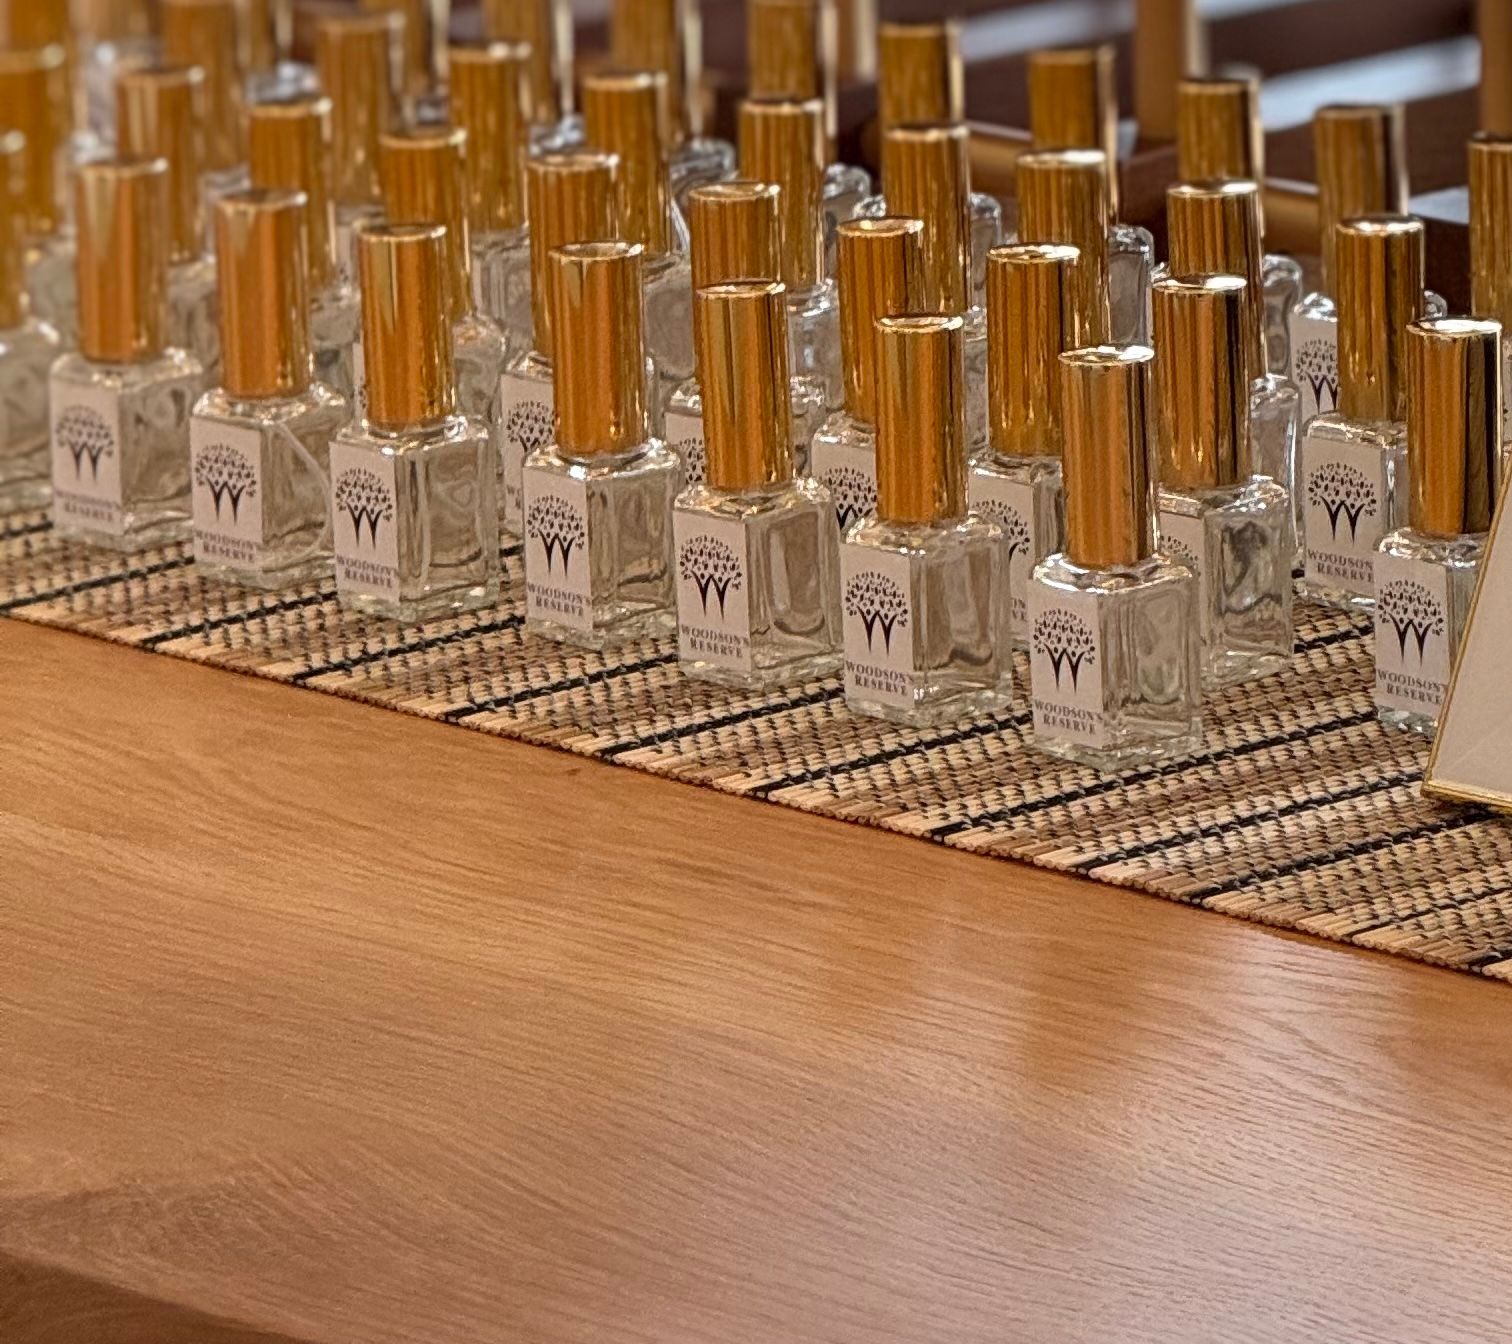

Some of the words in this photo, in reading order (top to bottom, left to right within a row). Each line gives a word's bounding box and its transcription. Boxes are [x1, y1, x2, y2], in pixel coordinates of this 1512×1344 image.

[689, 636, 743, 659] RESERVE
[855, 674, 909, 697] RESERVE
[1386, 682, 1443, 706] RESERVE
[1043, 713, 1098, 736] RESERVE
